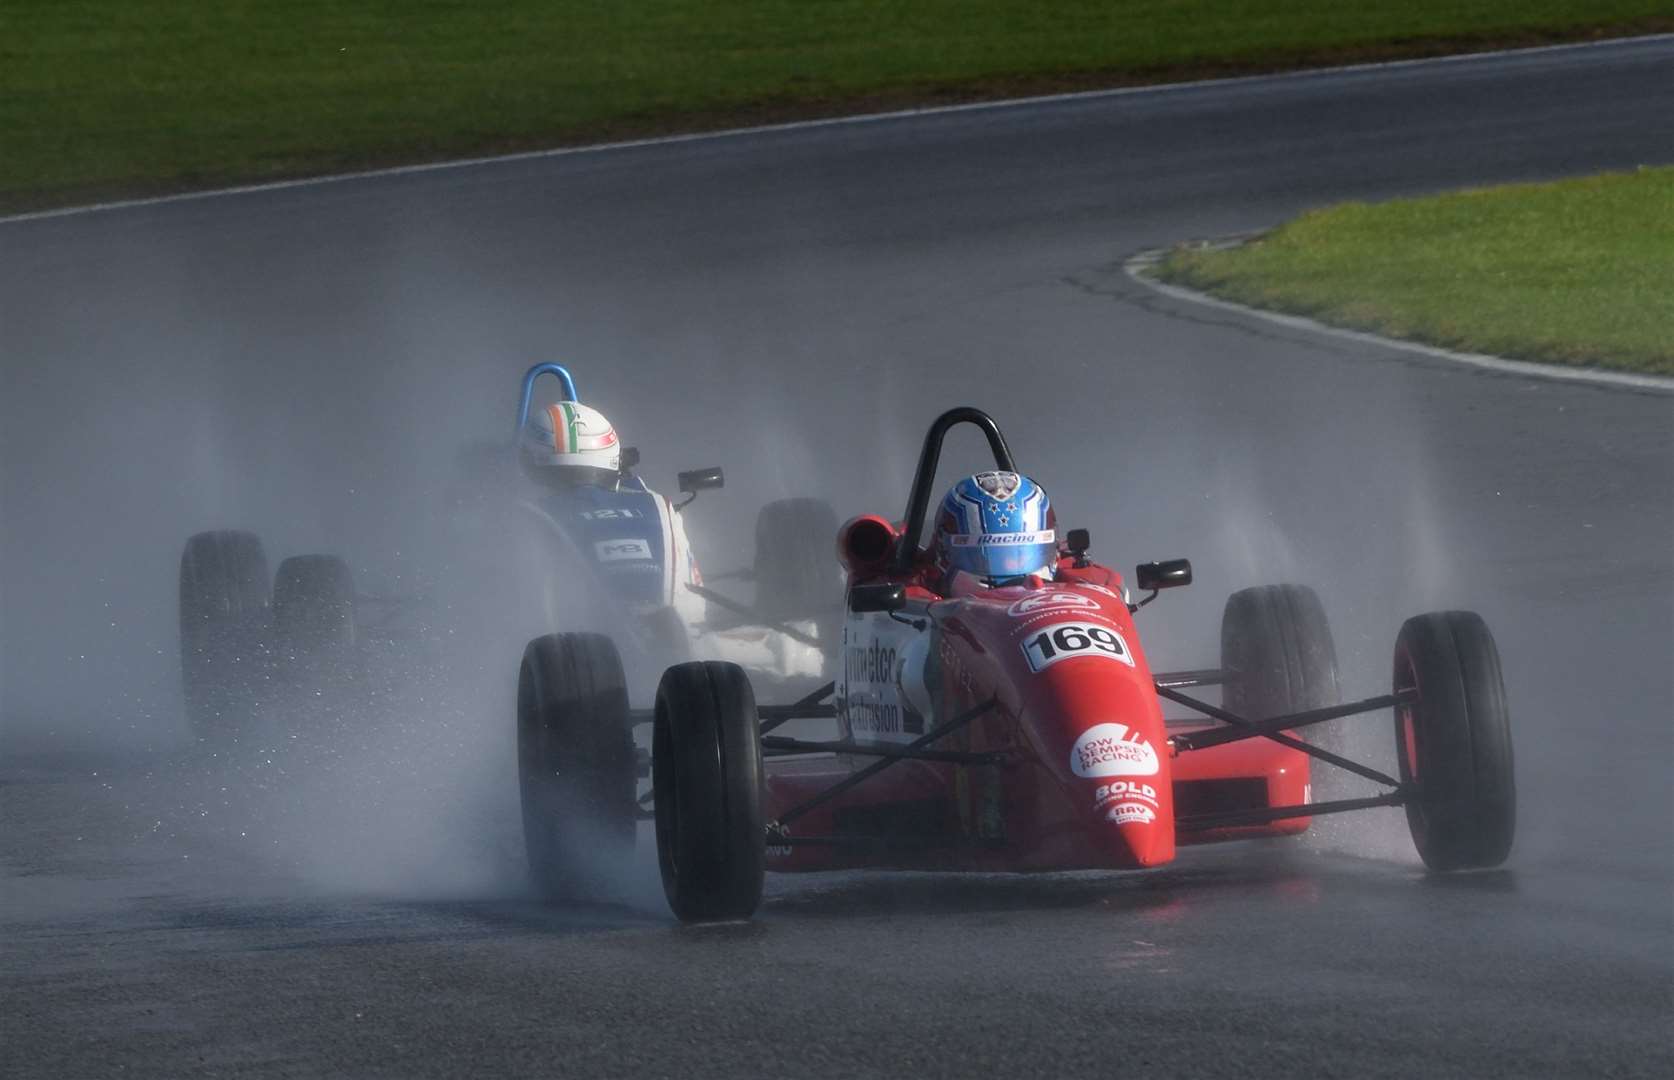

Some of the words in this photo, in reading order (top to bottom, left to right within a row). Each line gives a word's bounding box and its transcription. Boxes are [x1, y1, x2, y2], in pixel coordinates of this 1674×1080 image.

[978, 534, 1035, 546] iRacing
[1028, 626, 1123, 660] 169
[1076, 737, 1113, 756] LOW
[1080, 743, 1150, 763] DEMPSEY
[1081, 752, 1142, 772] RACING
[1095, 781, 1157, 801] BOLD
[1115, 806, 1146, 816] RAY
